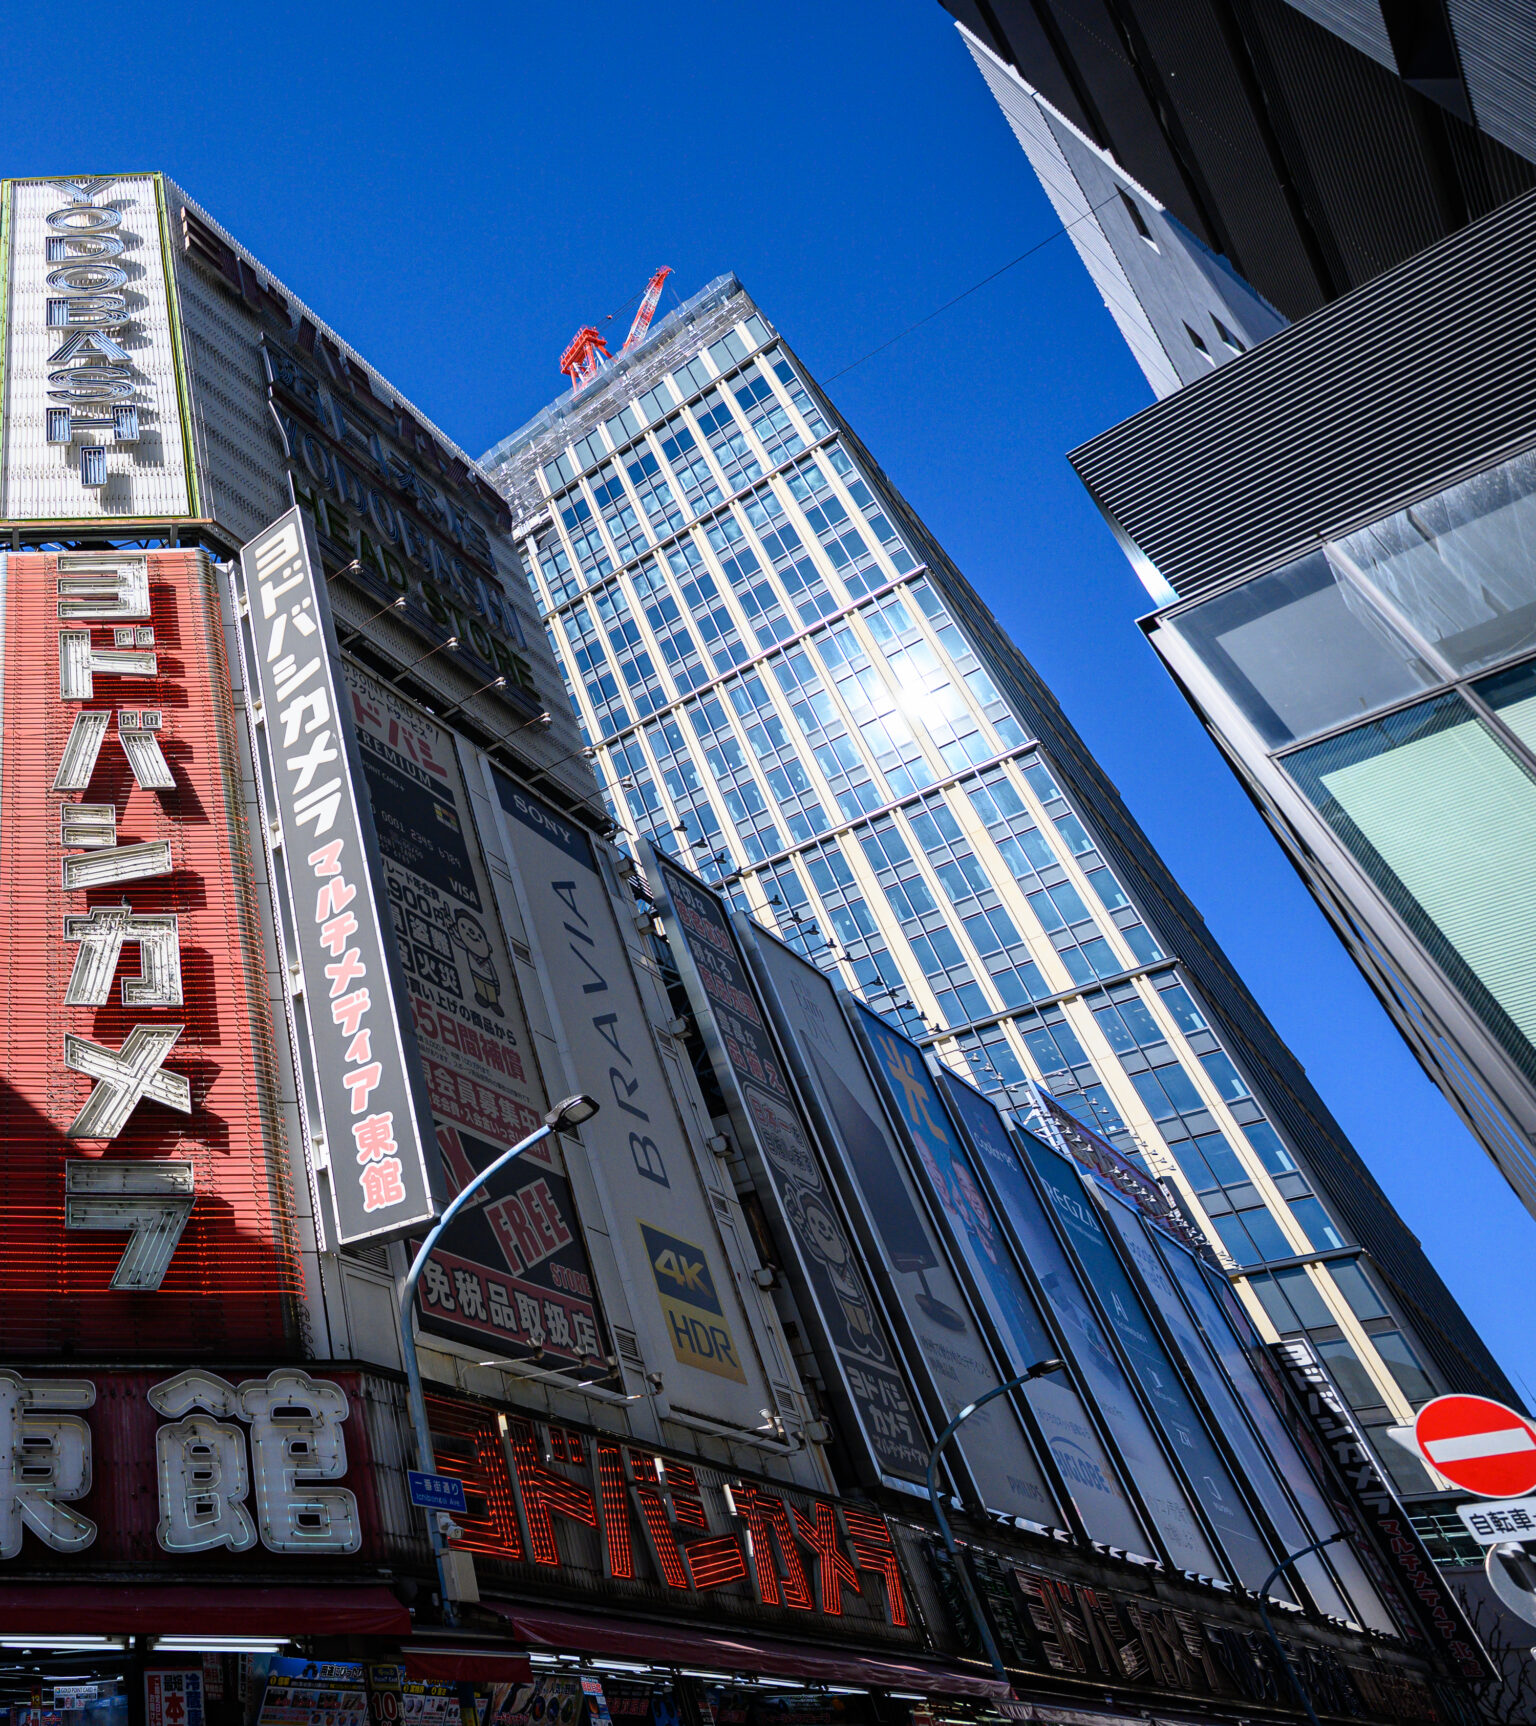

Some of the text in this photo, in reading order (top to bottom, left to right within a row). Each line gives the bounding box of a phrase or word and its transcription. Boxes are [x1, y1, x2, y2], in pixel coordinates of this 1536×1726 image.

[45, 178, 140, 489] YODOBASHI
[182, 205, 513, 534] ヨドバシカメラ
[269, 388, 528, 651] YODOBASHI
[287, 470, 542, 701] HEAD STORE
[254, 522, 343, 838] ヨドバシカメラ
[308, 838, 407, 1213] マルチメディア東館
[512, 793, 573, 845] SONY
[53, 554, 197, 1292] ヨドバシカメラ
[448, 877, 478, 906] VISA
[551, 880, 671, 1190] BRAVIA
[482, 1176, 574, 1278] FREE
[1043, 1178, 1102, 1234] REGZA
[423, 1258, 600, 1359] 免税品取扱店
[550, 1261, 592, 1297] STORE
[653, 1247, 715, 1300] 4K
[667, 1309, 739, 1370] HDR
[846, 1364, 911, 1412] ヨドバシ
[868, 1403, 914, 1445] カメラ
[1278, 1341, 1392, 1519] ヨドバシカメラ
[414, 1478, 461, 1497] 一番街通り
[422, 1395, 910, 1628] ヨドバシカメラ
[1468, 1507, 1536, 1536] 自転車
